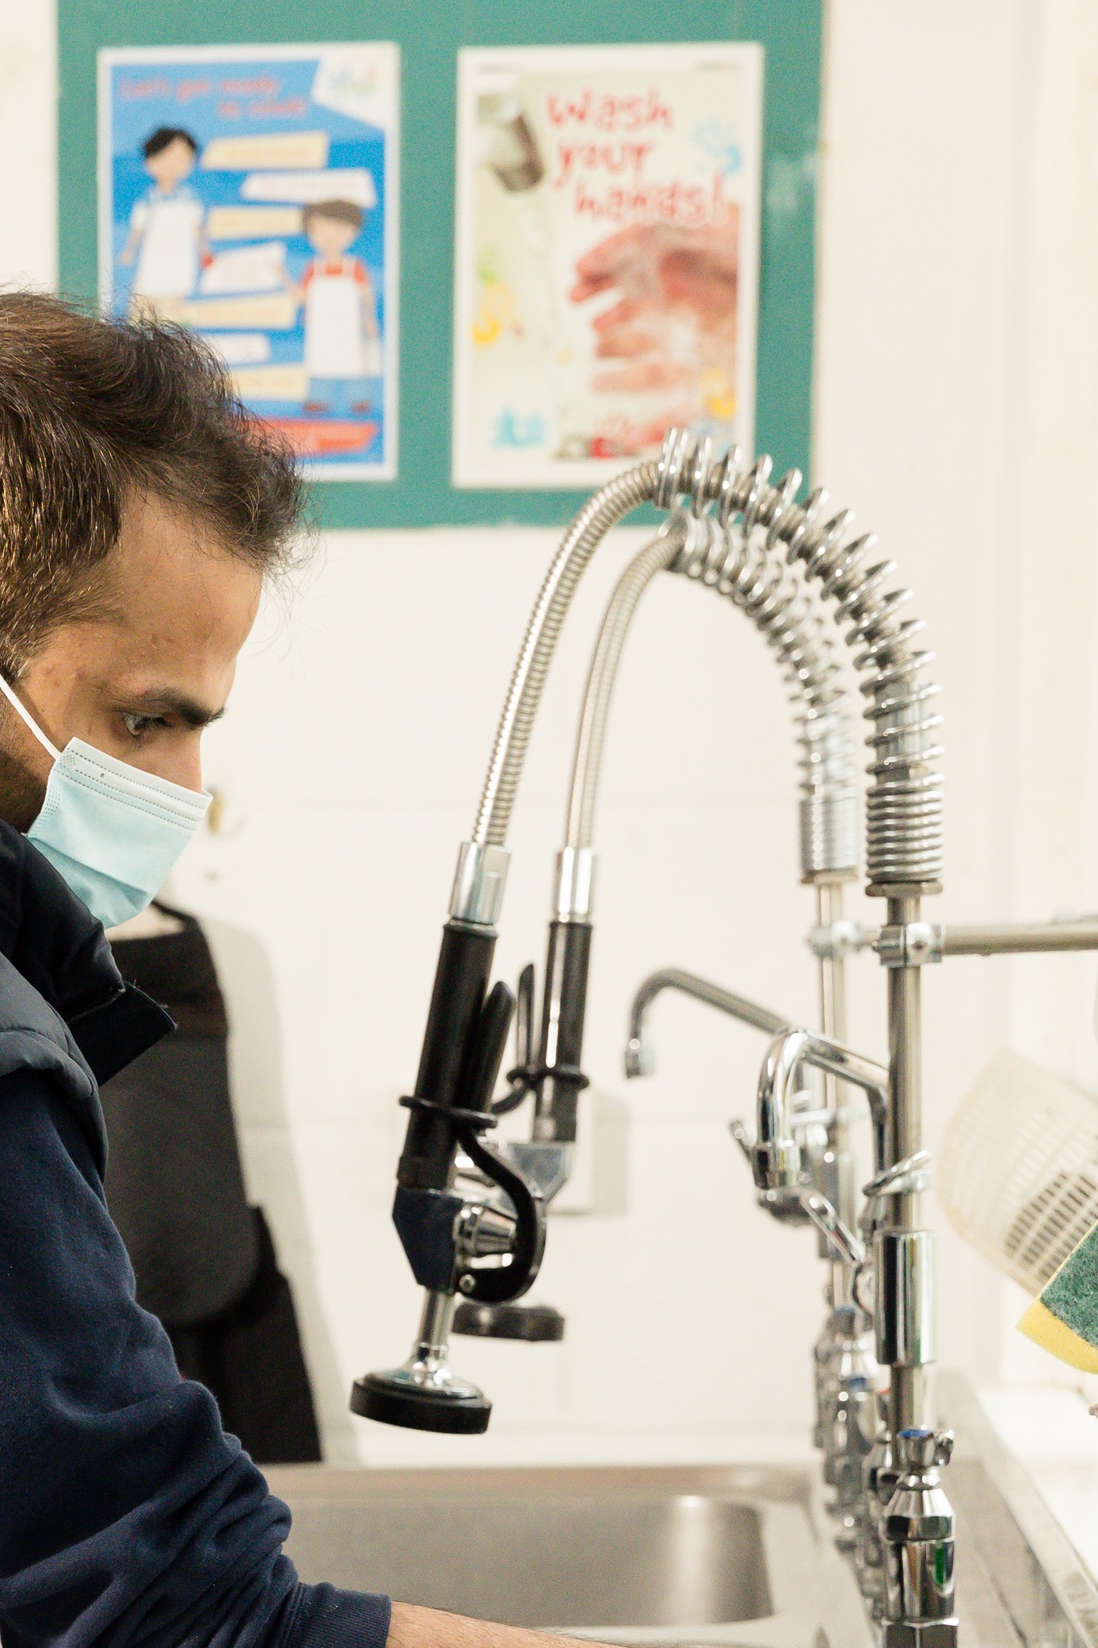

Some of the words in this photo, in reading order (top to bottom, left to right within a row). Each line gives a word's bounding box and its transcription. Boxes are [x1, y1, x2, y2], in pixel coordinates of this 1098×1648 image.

[547, 89, 672, 131] Wash
[556, 142, 654, 189] your
[575, 169, 724, 219] hands!
